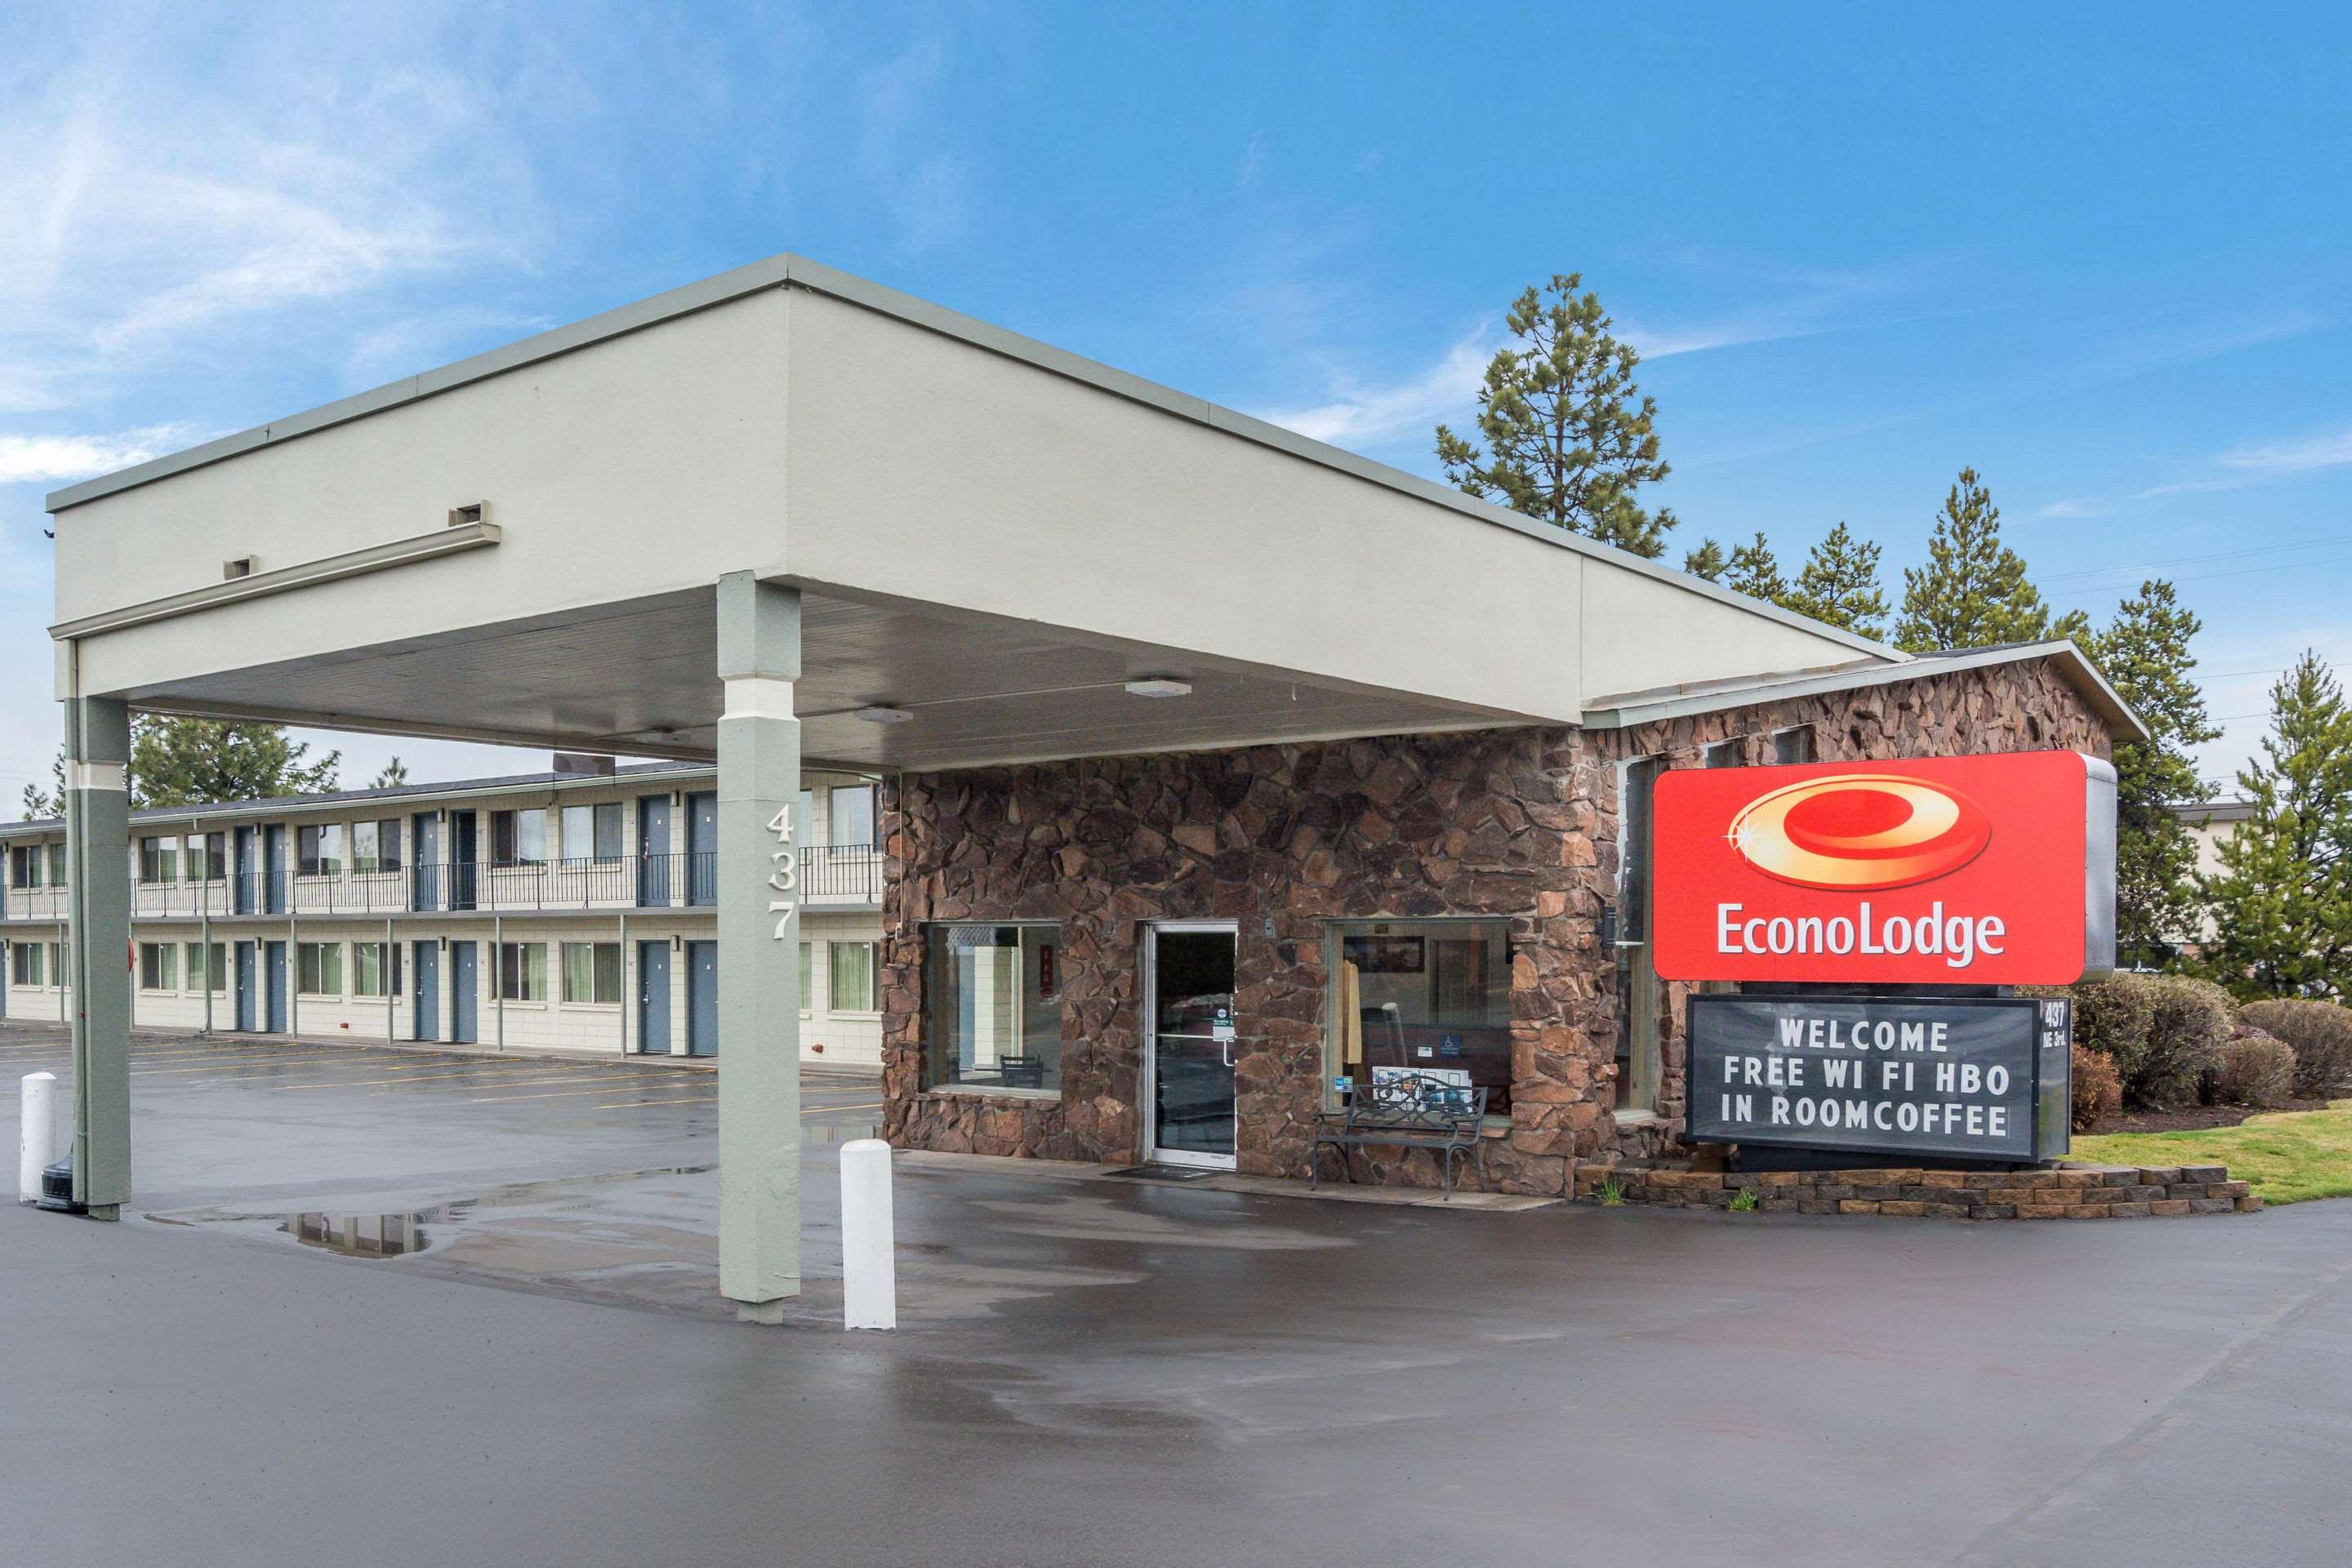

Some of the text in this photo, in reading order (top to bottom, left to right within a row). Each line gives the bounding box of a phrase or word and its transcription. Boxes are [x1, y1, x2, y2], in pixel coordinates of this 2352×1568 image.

[765, 803, 797, 940] 437
[1717, 901, 2005, 968] EconoLodge
[2045, 1001, 2065, 1027] 437
[1780, 1018, 1948, 1053] WELCOME
[2042, 1031, 2053, 1049] NE
[1724, 1056, 2010, 1096] FREE WI FI HBO
[1722, 1094, 1752, 1122] IN
